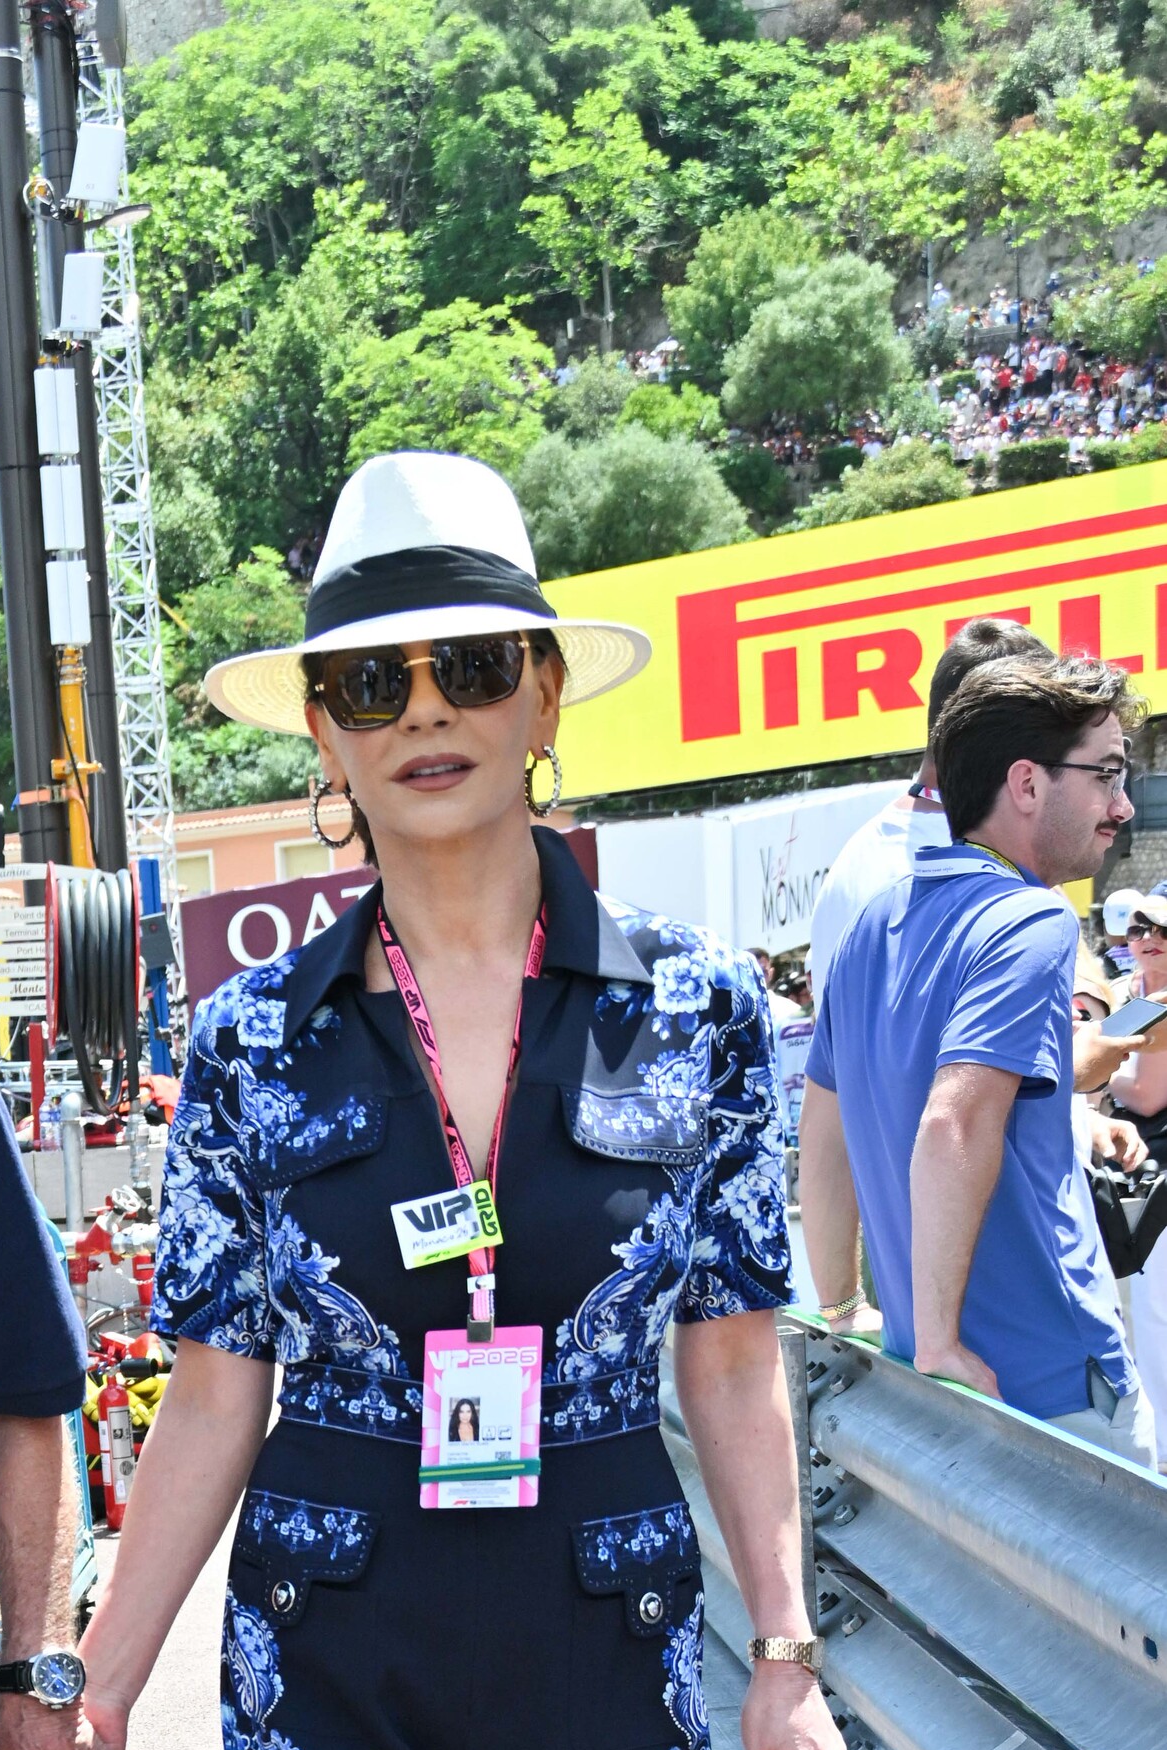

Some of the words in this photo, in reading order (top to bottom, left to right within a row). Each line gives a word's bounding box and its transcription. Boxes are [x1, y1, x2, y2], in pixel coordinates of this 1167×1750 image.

[677, 500, 1167, 743] PIRL
[761, 867, 830, 933] MONAC
[4, 928, 39, 938] Terminal
[390, 948, 414, 989] 2026
[404, 988, 423, 1014] VIP
[402, 1193, 473, 1233] VIP
[474, 1188, 499, 1237] GRID
